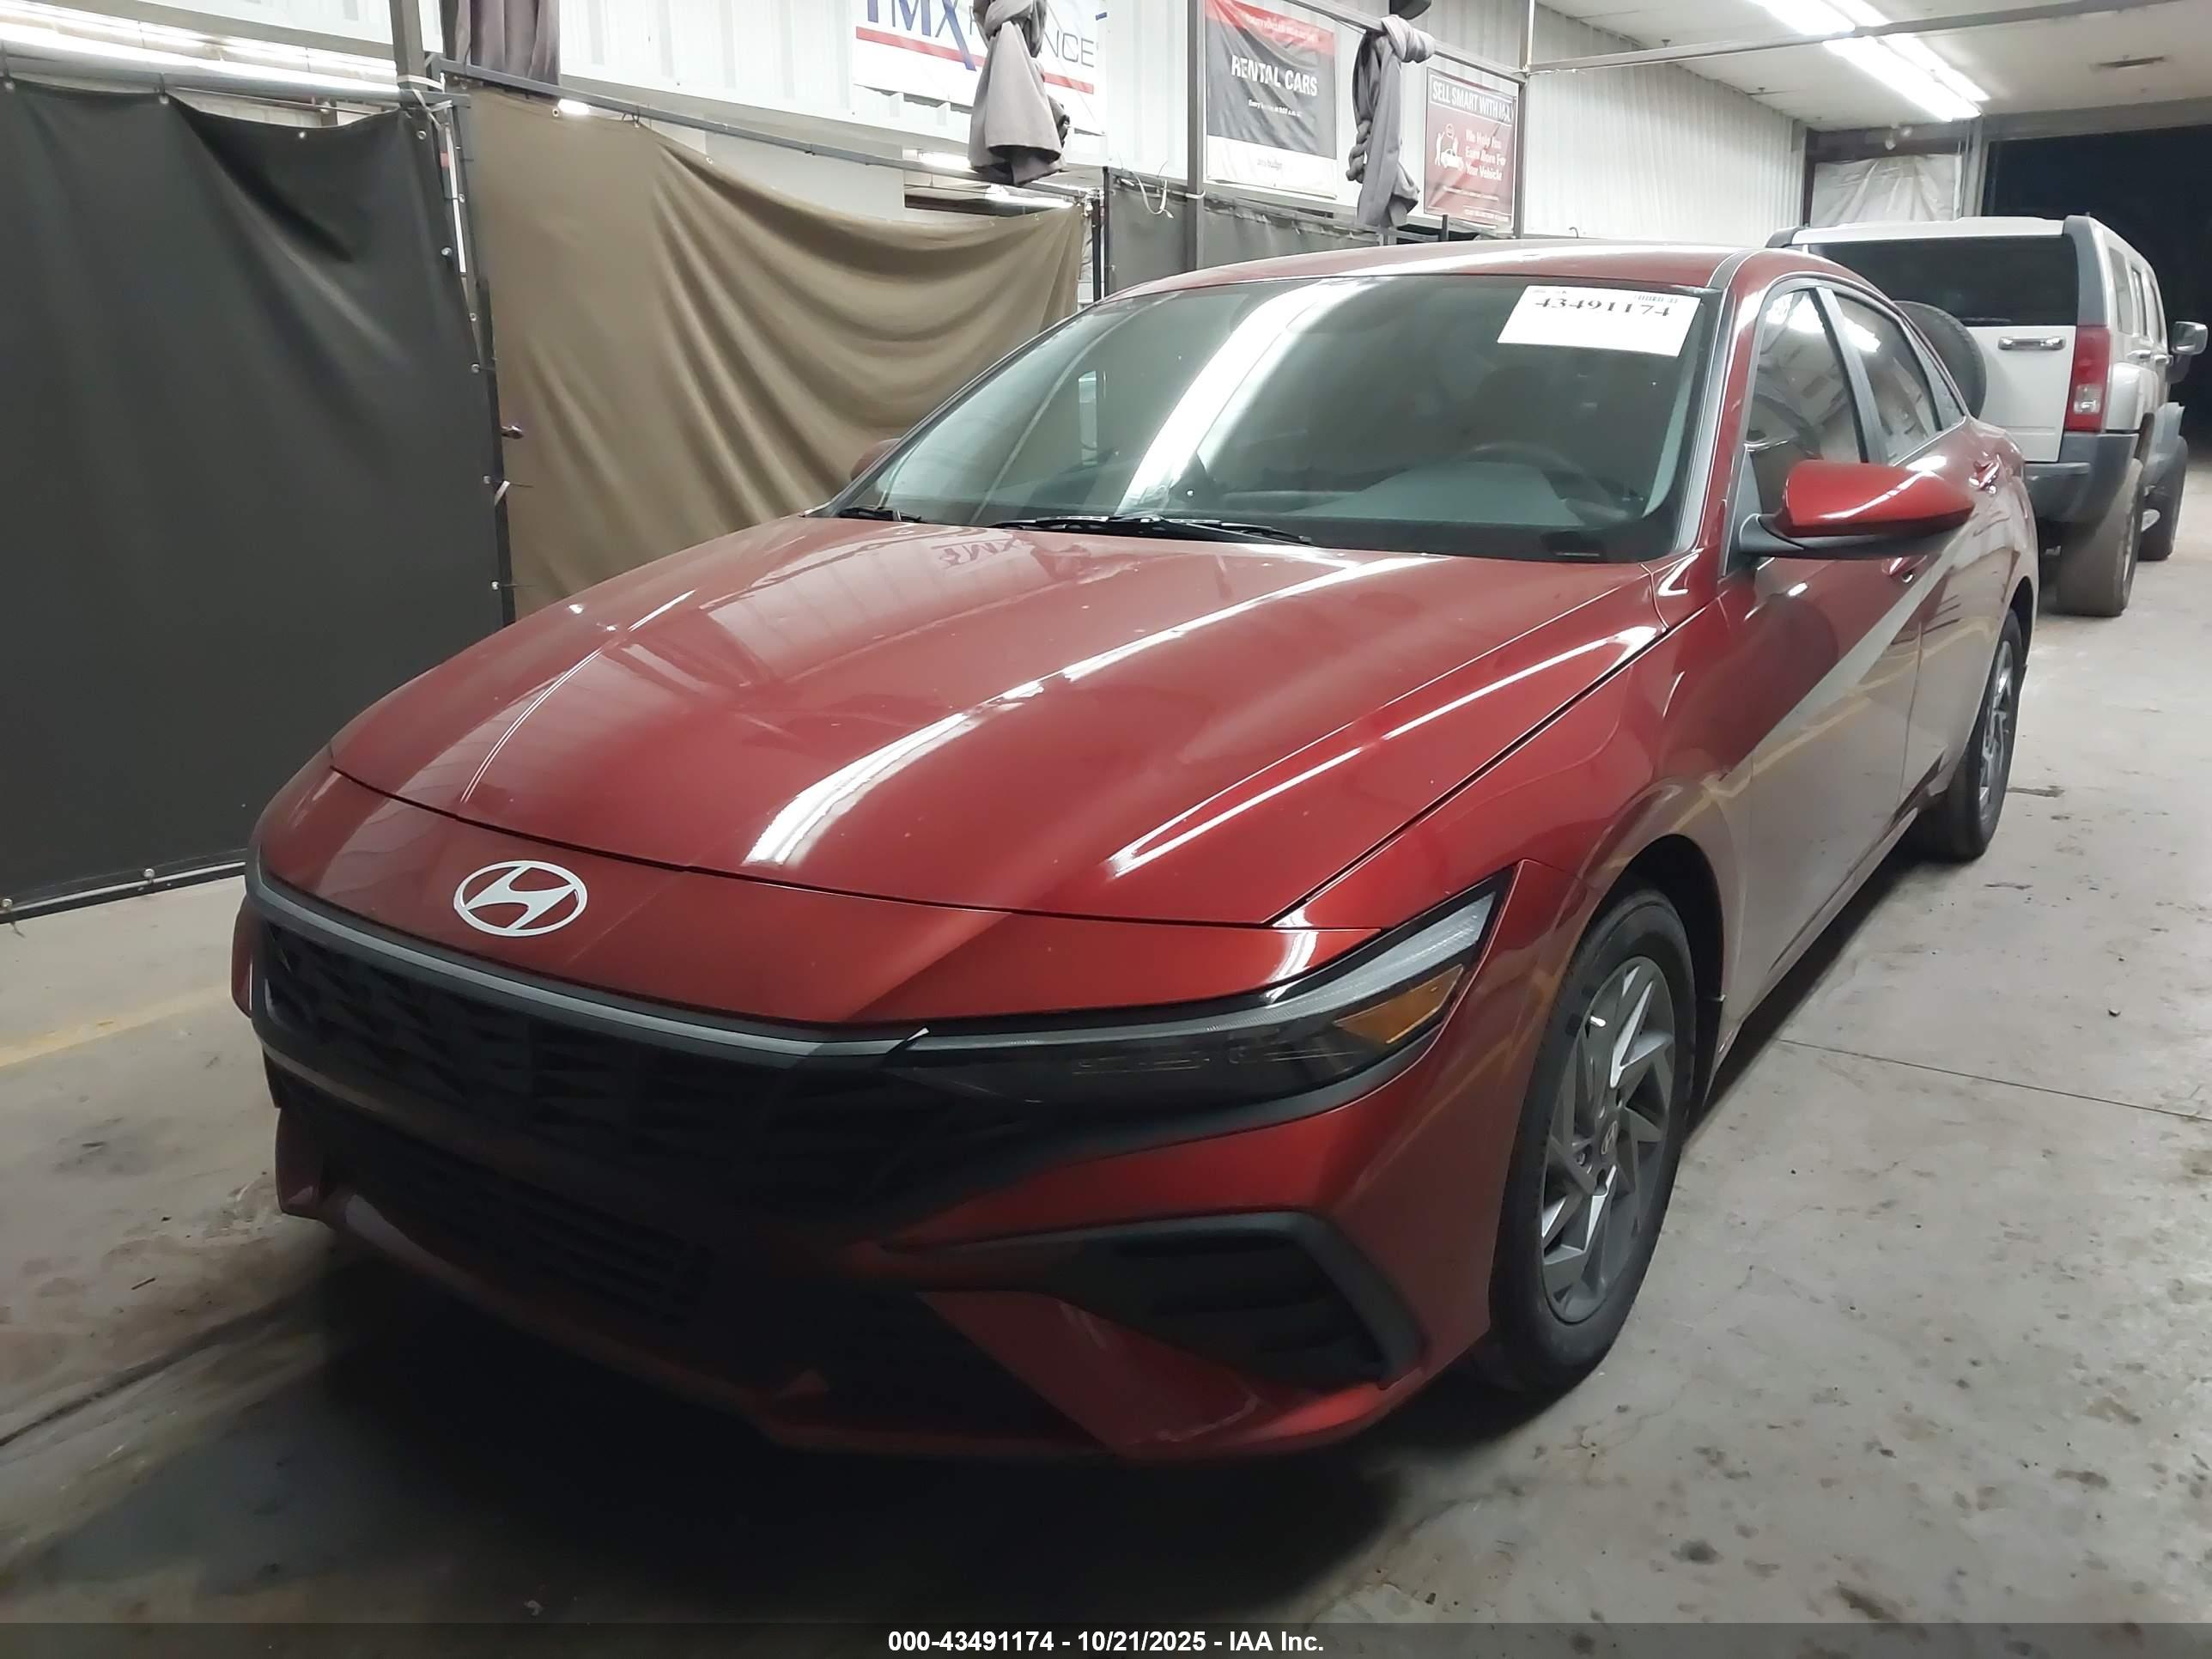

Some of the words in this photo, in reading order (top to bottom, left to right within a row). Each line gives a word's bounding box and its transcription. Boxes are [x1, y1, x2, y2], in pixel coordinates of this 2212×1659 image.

[1231, 54, 1281, 88] RENTAL
[1284, 70, 1318, 97] CARS
[1432, 80, 1451, 103] SELL
[1451, 87, 1479, 112] SMART
[1479, 96, 1499, 118] WITH
[1535, 297, 1670, 317] 43491174
